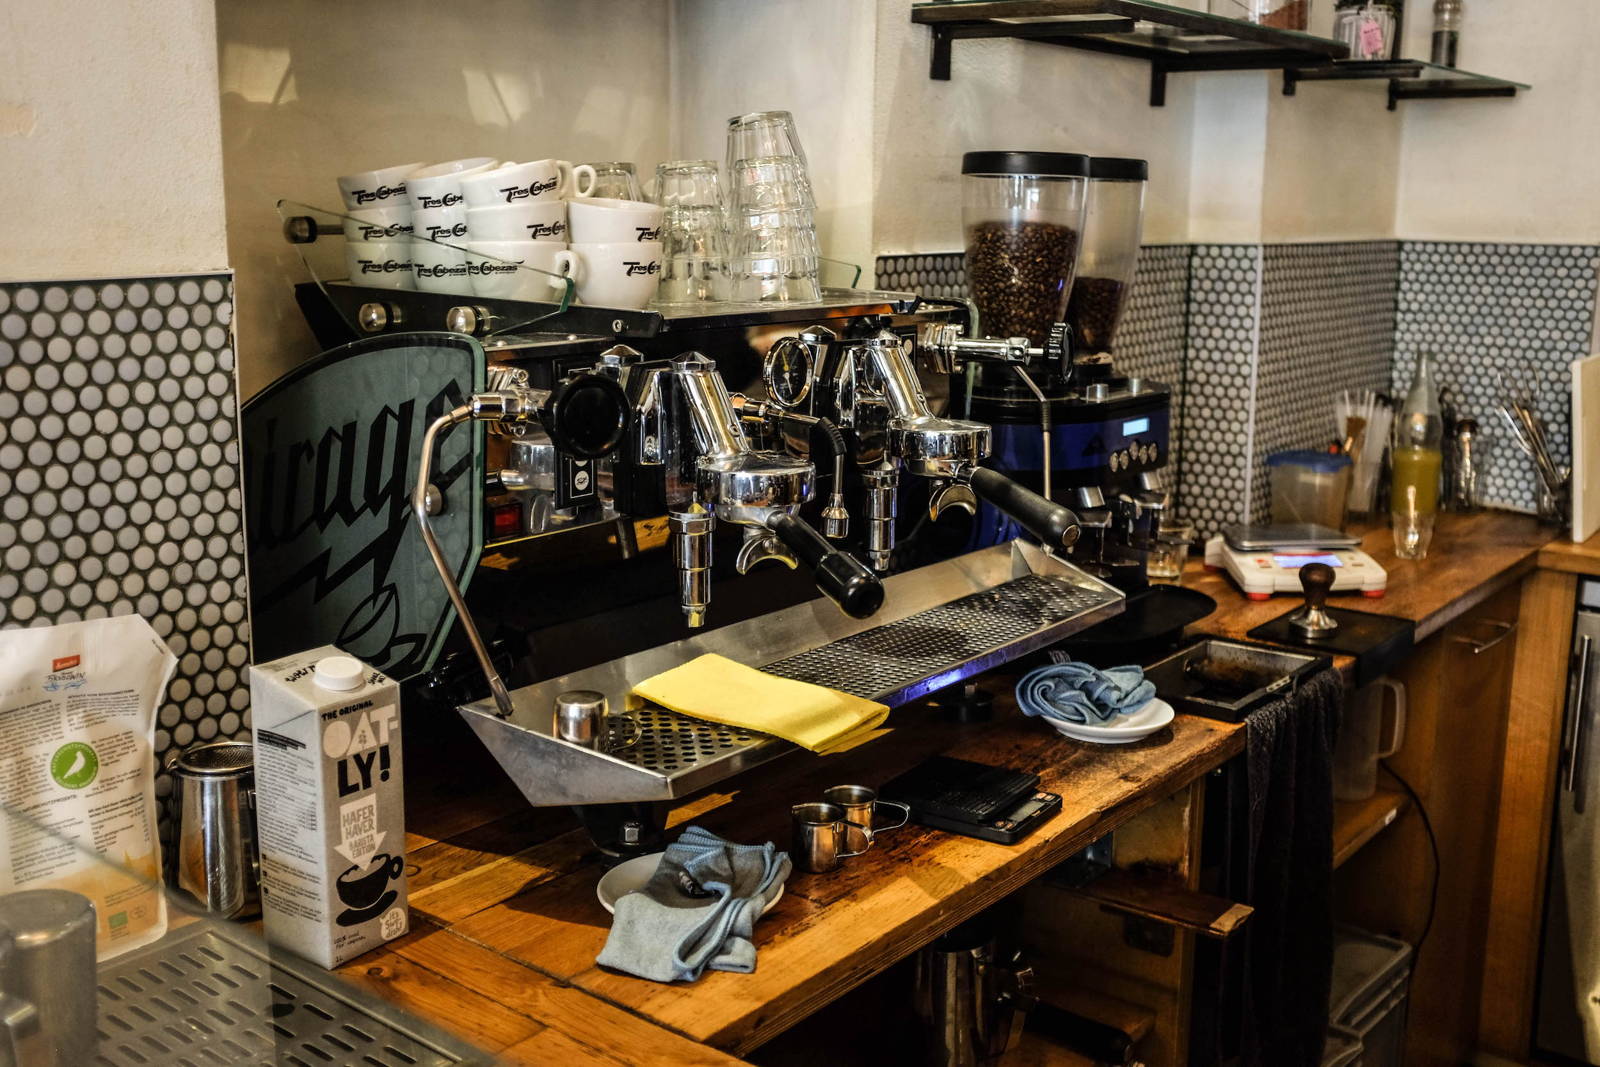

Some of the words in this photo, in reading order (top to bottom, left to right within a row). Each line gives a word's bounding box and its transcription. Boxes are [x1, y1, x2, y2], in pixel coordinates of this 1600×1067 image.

[352, 190, 376, 205] Tres
[417, 196, 442, 209] Tres
[500, 186, 529, 203] Tres
[426, 226, 451, 241] Tres
[526, 223, 551, 240] Tres
[480, 260, 520, 276] Cabezas
[623, 262, 647, 277] Tres
[321, 710, 338, 721] THE
[339, 700, 374, 716] ORIGINAL
[337, 744, 390, 798] LY!
[342, 804, 375, 828] HAFER
[345, 818, 375, 840] HAVER
